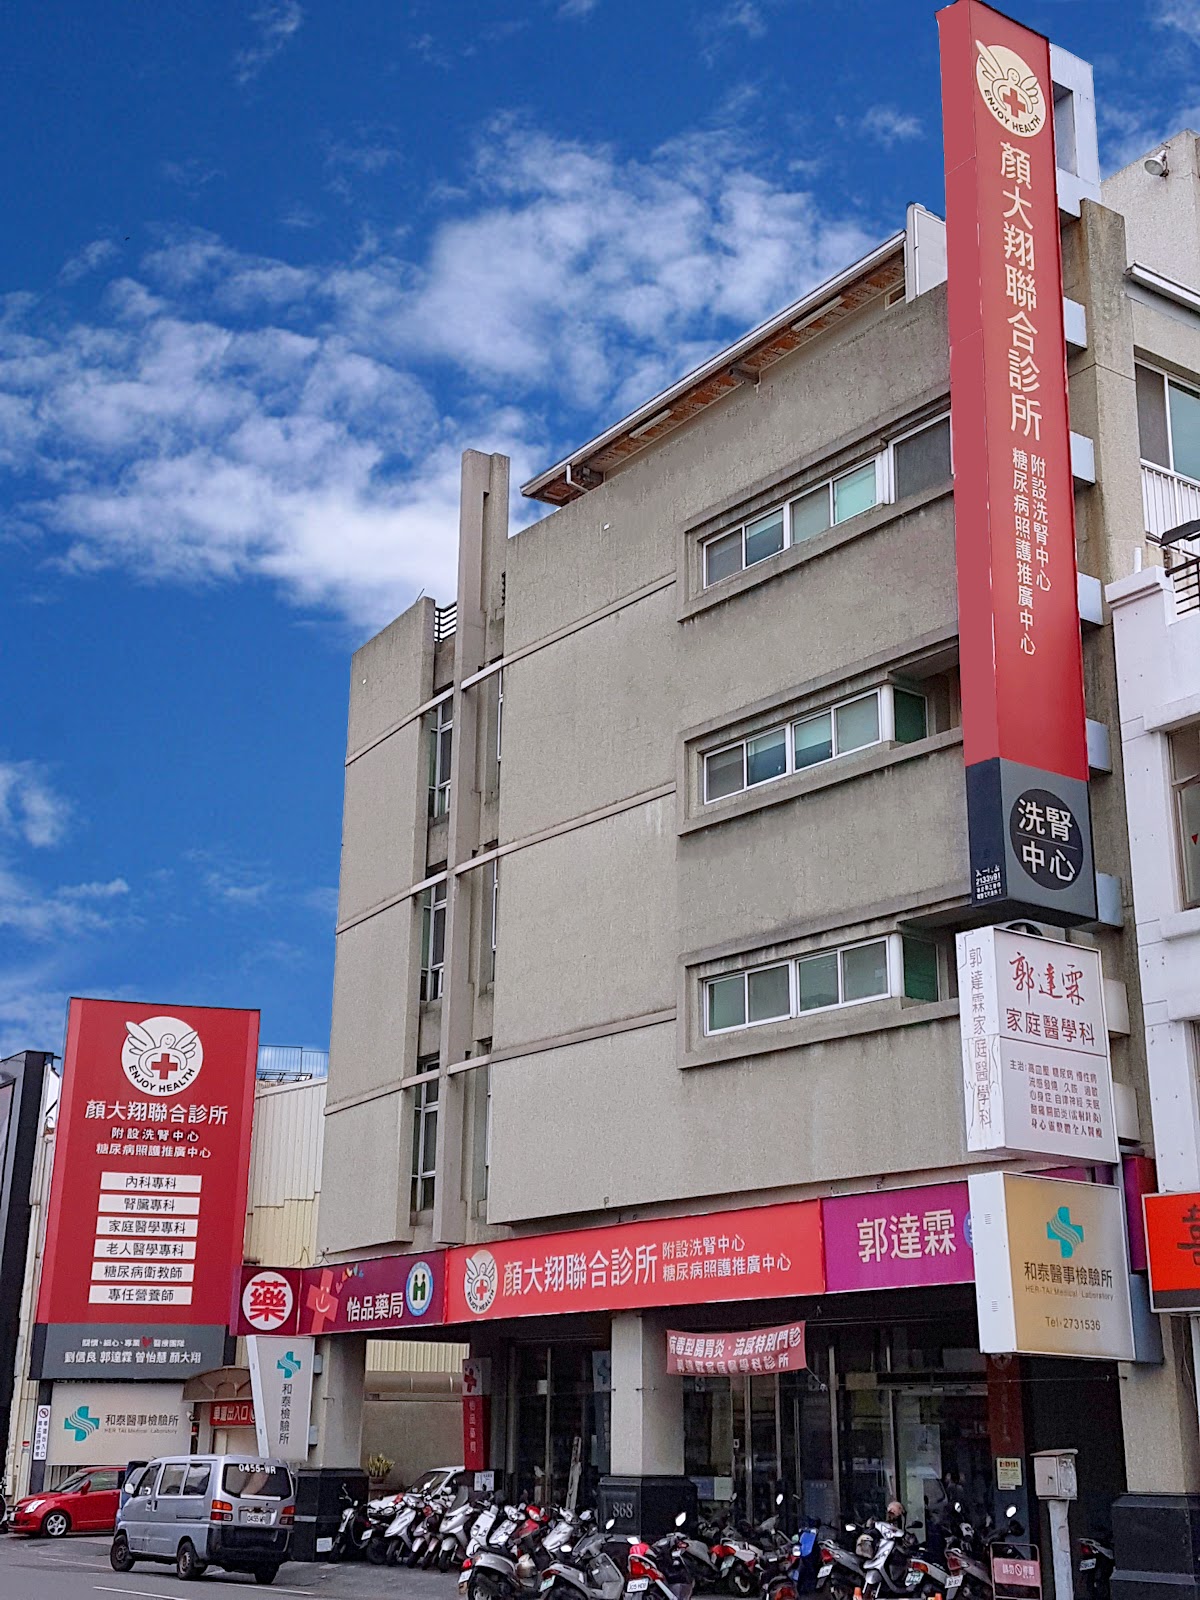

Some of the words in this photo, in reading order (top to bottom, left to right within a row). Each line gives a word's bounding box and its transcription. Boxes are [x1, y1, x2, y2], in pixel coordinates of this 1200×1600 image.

[984, 89, 1010, 125] ENJOY
[1012, 115, 1042, 133] HEALTH
[1000, 141, 1042, 441] 顏大翔聯合診所
[1030, 454, 1051, 592] 附設洗腎中心
[1012, 447, 1036, 655] 糖尿病照護推廣中心
[1018, 798, 1073, 842] 洗腎
[1022, 840, 1075, 882] 中心
[969, 947, 992, 1129] 郭達霖家庭醫學科
[1006, 1008, 1095, 1047] 家庭醫學科
[128, 1065, 156, 1091] ENJOY
[158, 1068, 195, 1093] HEALTH
[84, 1099, 229, 1125] 顏大翔聯合診所
[111, 1127, 199, 1142] 附設洗腎中心
[95, 1143, 211, 1159] 糖尿病照護推廣中心
[124, 1198, 175, 1211] 腎臟專科
[108, 1220, 186, 1234] 家庭醫學專科
[856, 1208, 957, 1263] 郭達霖
[106, 1242, 184, 1256] 老人醫學專科
[662, 1234, 746, 1260] 附設洗腎中心
[104, 1265, 183, 1279] 糖尿病衛教師
[502, 1243, 658, 1297] 顏大翔聯合診所
[662, 1253, 792, 1283] 糖尿病照護推廣中心
[1024, 1261, 1113, 1288] 和泰醫事檢驗所
[108, 1288, 174, 1302] 專任營養師
[250, 1280, 287, 1322] 藥
[346, 1292, 403, 1323] 怡品藥局
[466, 1291, 479, 1311] ENJOY
[478, 1289, 495, 1311] HEALTH
[1081, 1291, 1113, 1301] Laboratory
[169, 1351, 201, 1363] 顏大翔
[105, 1414, 179, 1427] 和泰醫事檢驗所
[213, 1405, 249, 1422] 車輛出入口
[279, 1383, 293, 1445] 和泰檢驗所
[238, 1463, 277, 1475] 0455-WR
[612, 1502, 634, 1519] 868
